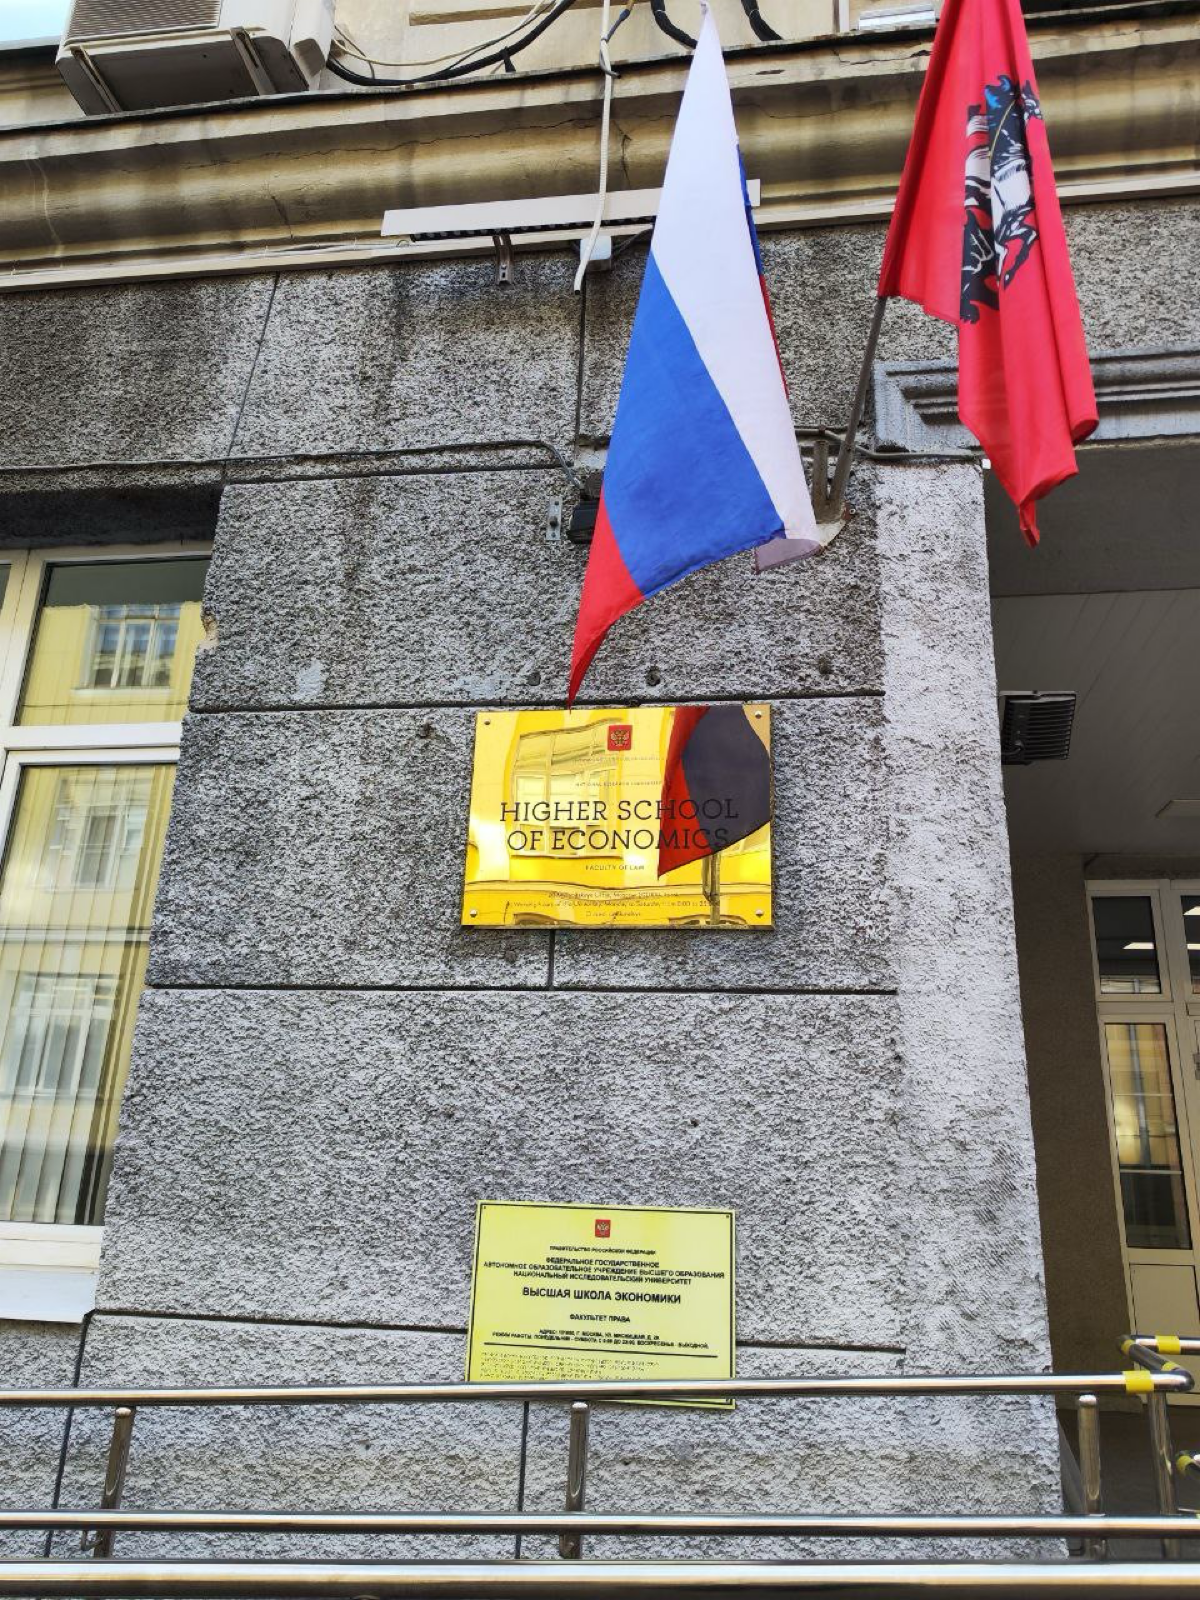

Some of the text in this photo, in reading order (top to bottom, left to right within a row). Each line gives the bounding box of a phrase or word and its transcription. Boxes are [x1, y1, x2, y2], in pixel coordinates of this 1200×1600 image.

[500, 798, 740, 822] HIGHER SCHOOL
[507, 828, 730, 851] OF ECONOMICS
[483, 1261, 725, 1279] АВТОНОМНОЕ ОБРАЗОВАТЕЛЬНОЕ УЧРЕЖДЕНИЕ ВЫСШЕГО ОБРАЗОВАНИЯ
[546, 1257, 659, 1268] ФЕДЕРАЛЬНОЕ ГОСУДАРСТВЕННОЕ
[513, 1271, 691, 1286] НАЦИОНАЛЬНЫЙ ИССЛЕДОВАТЕЛЬСКИЙ УНИВЕРСИТЕТ
[522, 1286, 681, 1304] ВЫСШАЯ ШКОЛА ЭКОНОМИКИ
[569, 1314, 631, 1323] ФАКУЛЬТЕТ ПРАВА
